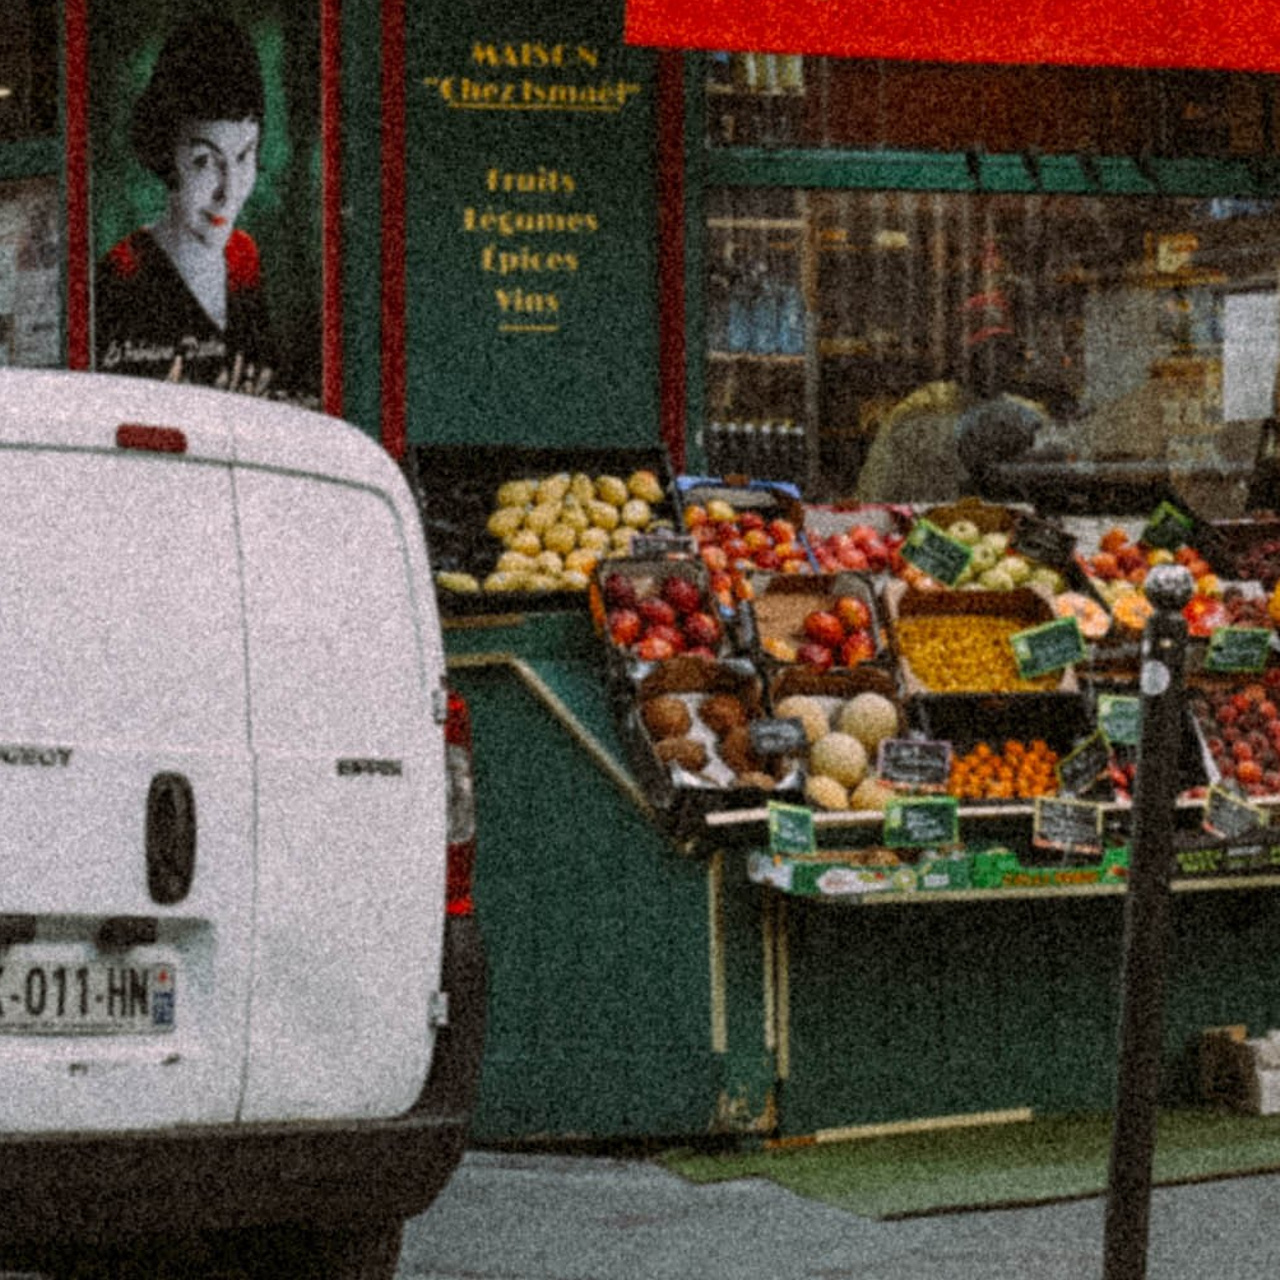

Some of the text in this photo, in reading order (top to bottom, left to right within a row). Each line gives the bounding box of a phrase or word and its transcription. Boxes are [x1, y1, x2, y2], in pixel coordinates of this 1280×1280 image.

[486, 166, 577, 193] Fruits
[495, 287, 561, 313] Vins
[0, 965, 150, 1018] -011-HN
